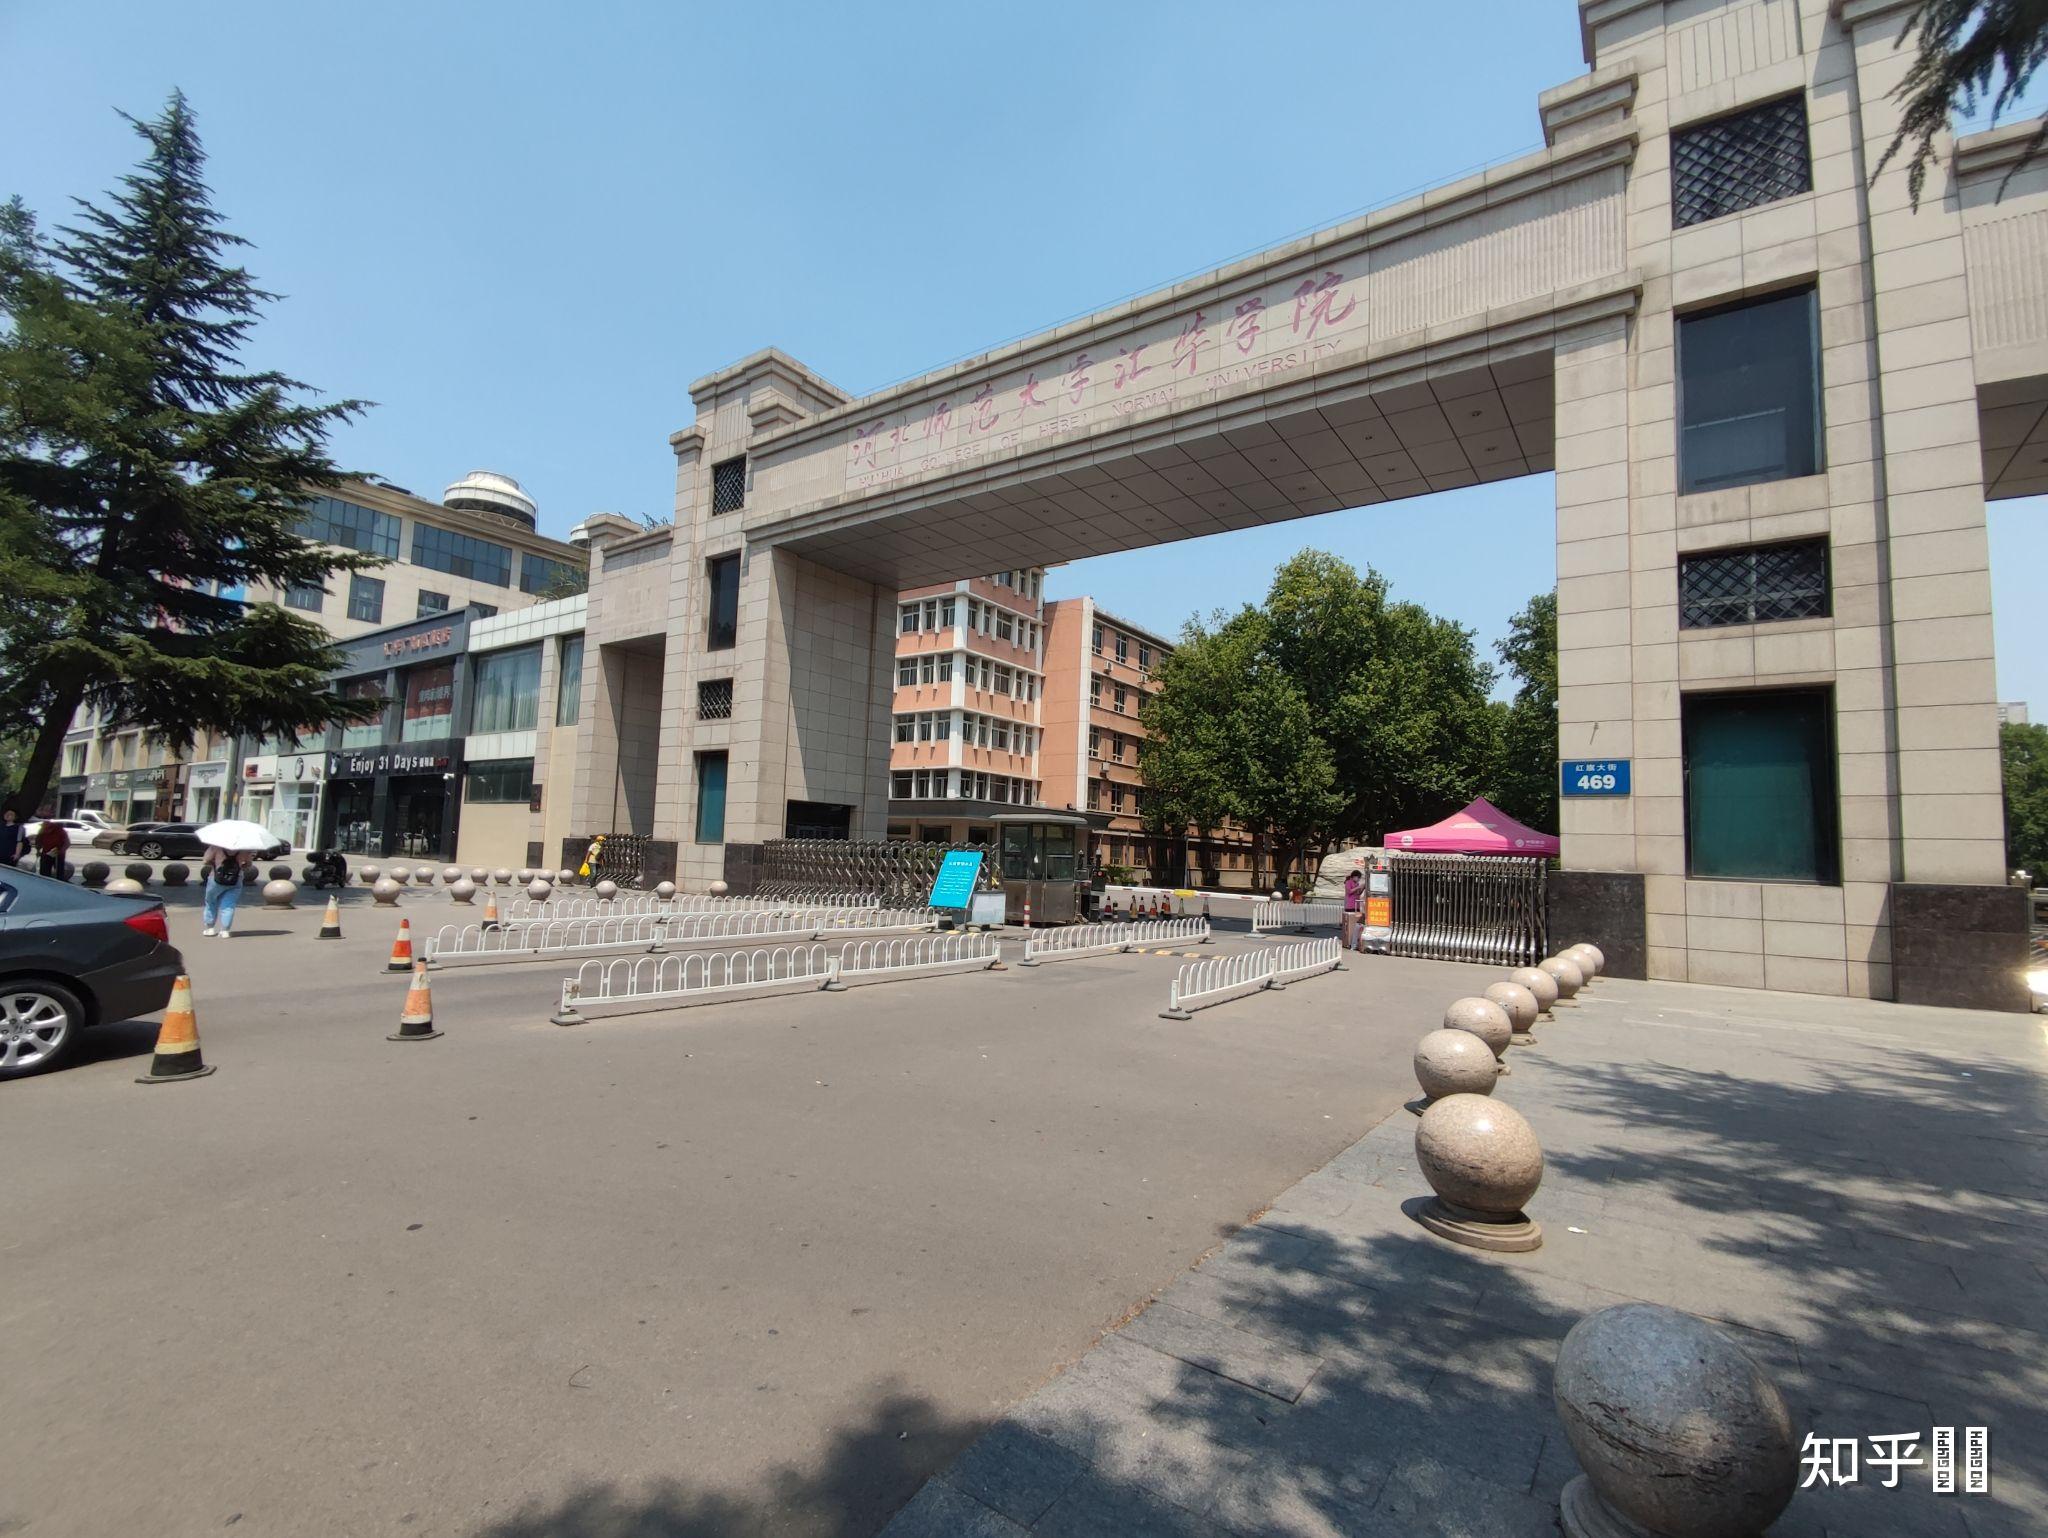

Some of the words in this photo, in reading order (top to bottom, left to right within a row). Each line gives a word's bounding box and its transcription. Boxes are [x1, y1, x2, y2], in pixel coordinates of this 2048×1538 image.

[920, 444, 981, 472] COLLEGE
[1000, 433, 1020, 450] OF
[1112, 388, 1174, 417] NORMAL
[1205, 339, 1341, 391] UNIVERSITY
[350, 758, 375, 774] Enjoy
[378, 755, 389, 770] 31
[394, 754, 417, 771] Days
[1575, 763, 1617, 772] 红旗大街
[1577, 774, 1616, 790] 469
